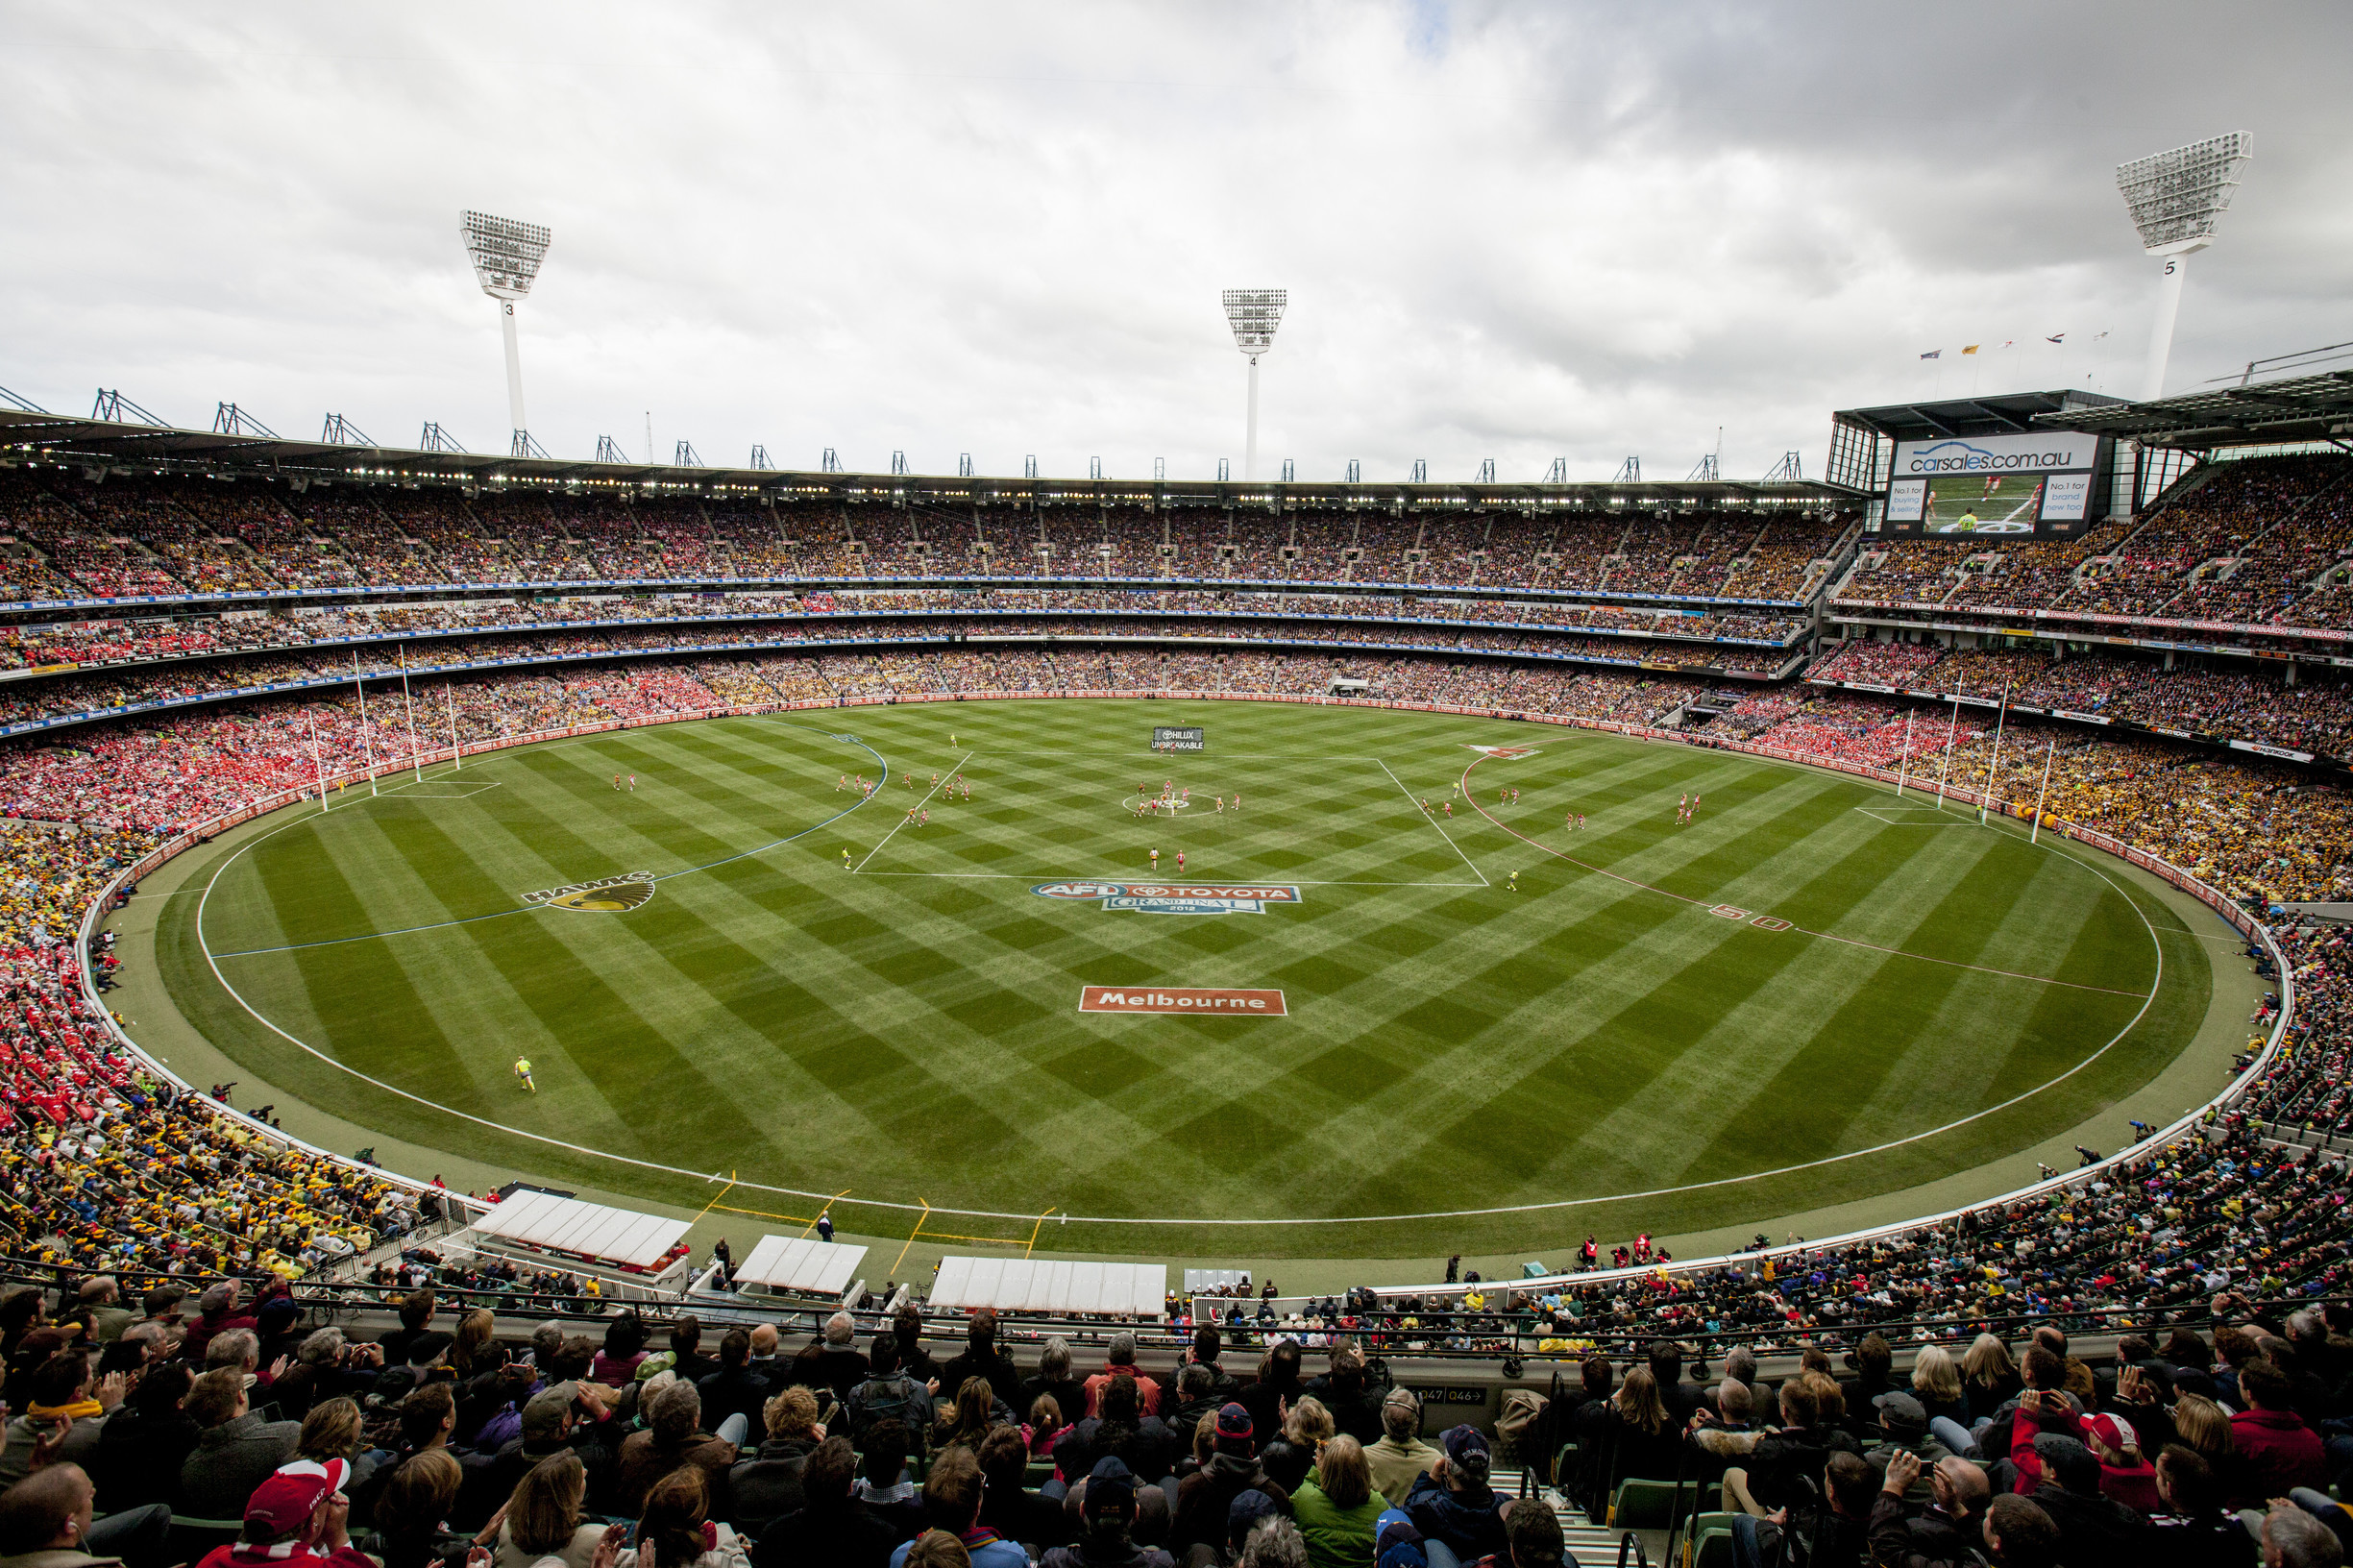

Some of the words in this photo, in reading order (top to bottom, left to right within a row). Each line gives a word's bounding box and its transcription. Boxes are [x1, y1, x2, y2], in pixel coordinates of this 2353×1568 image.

[2164, 261, 2175, 275] 5
[505, 304, 514, 316] 3
[1250, 357, 1256, 366] 4
[1911, 452, 2071, 472] carsales.com.au
[1894, 496, 1919, 504] buying
[12, 600, 25, 610] Sun
[2047, 611, 2079, 620] KENNARDS
[2194, 622, 2231, 630] KENNARDS
[2248, 626, 2285, 634] KENNARDS
[2302, 630, 2343, 639] KENNARDS
[165, 697, 184, 705] Herald
[50, 717, 69, 725] Herald
[10, 724, 30, 733] Herald
[545, 730, 567, 738] TOYOTA
[474, 742, 497, 751] TOYOTA
[1767, 749, 1789, 757] TOYOTA
[1803, 756, 1825, 764] TOYOTA
[1839, 762, 1861, 772] TOYOTA
[1876, 770, 1898, 780] TOYOTA
[1948, 789, 1972, 800] TOYOTA
[232, 808, 253, 821] TOYOTA
[200, 821, 221, 837] TOYOTA
[171, 837, 190, 851] TOYOTA
[2090, 835, 2113, 848] TOYOTA
[145, 852, 162, 868] TOYOTA
[521, 870, 655, 904] HAWKS
[1046, 883, 1119, 896] AFL
[1172, 888, 1290, 898] TOYOTA
[1184, 899, 1236, 907] FINAL
[1709, 904, 1794, 931] 50
[1099, 992, 1267, 1009] Melbourne
[1449, 1391, 1471, 1400] Q46
